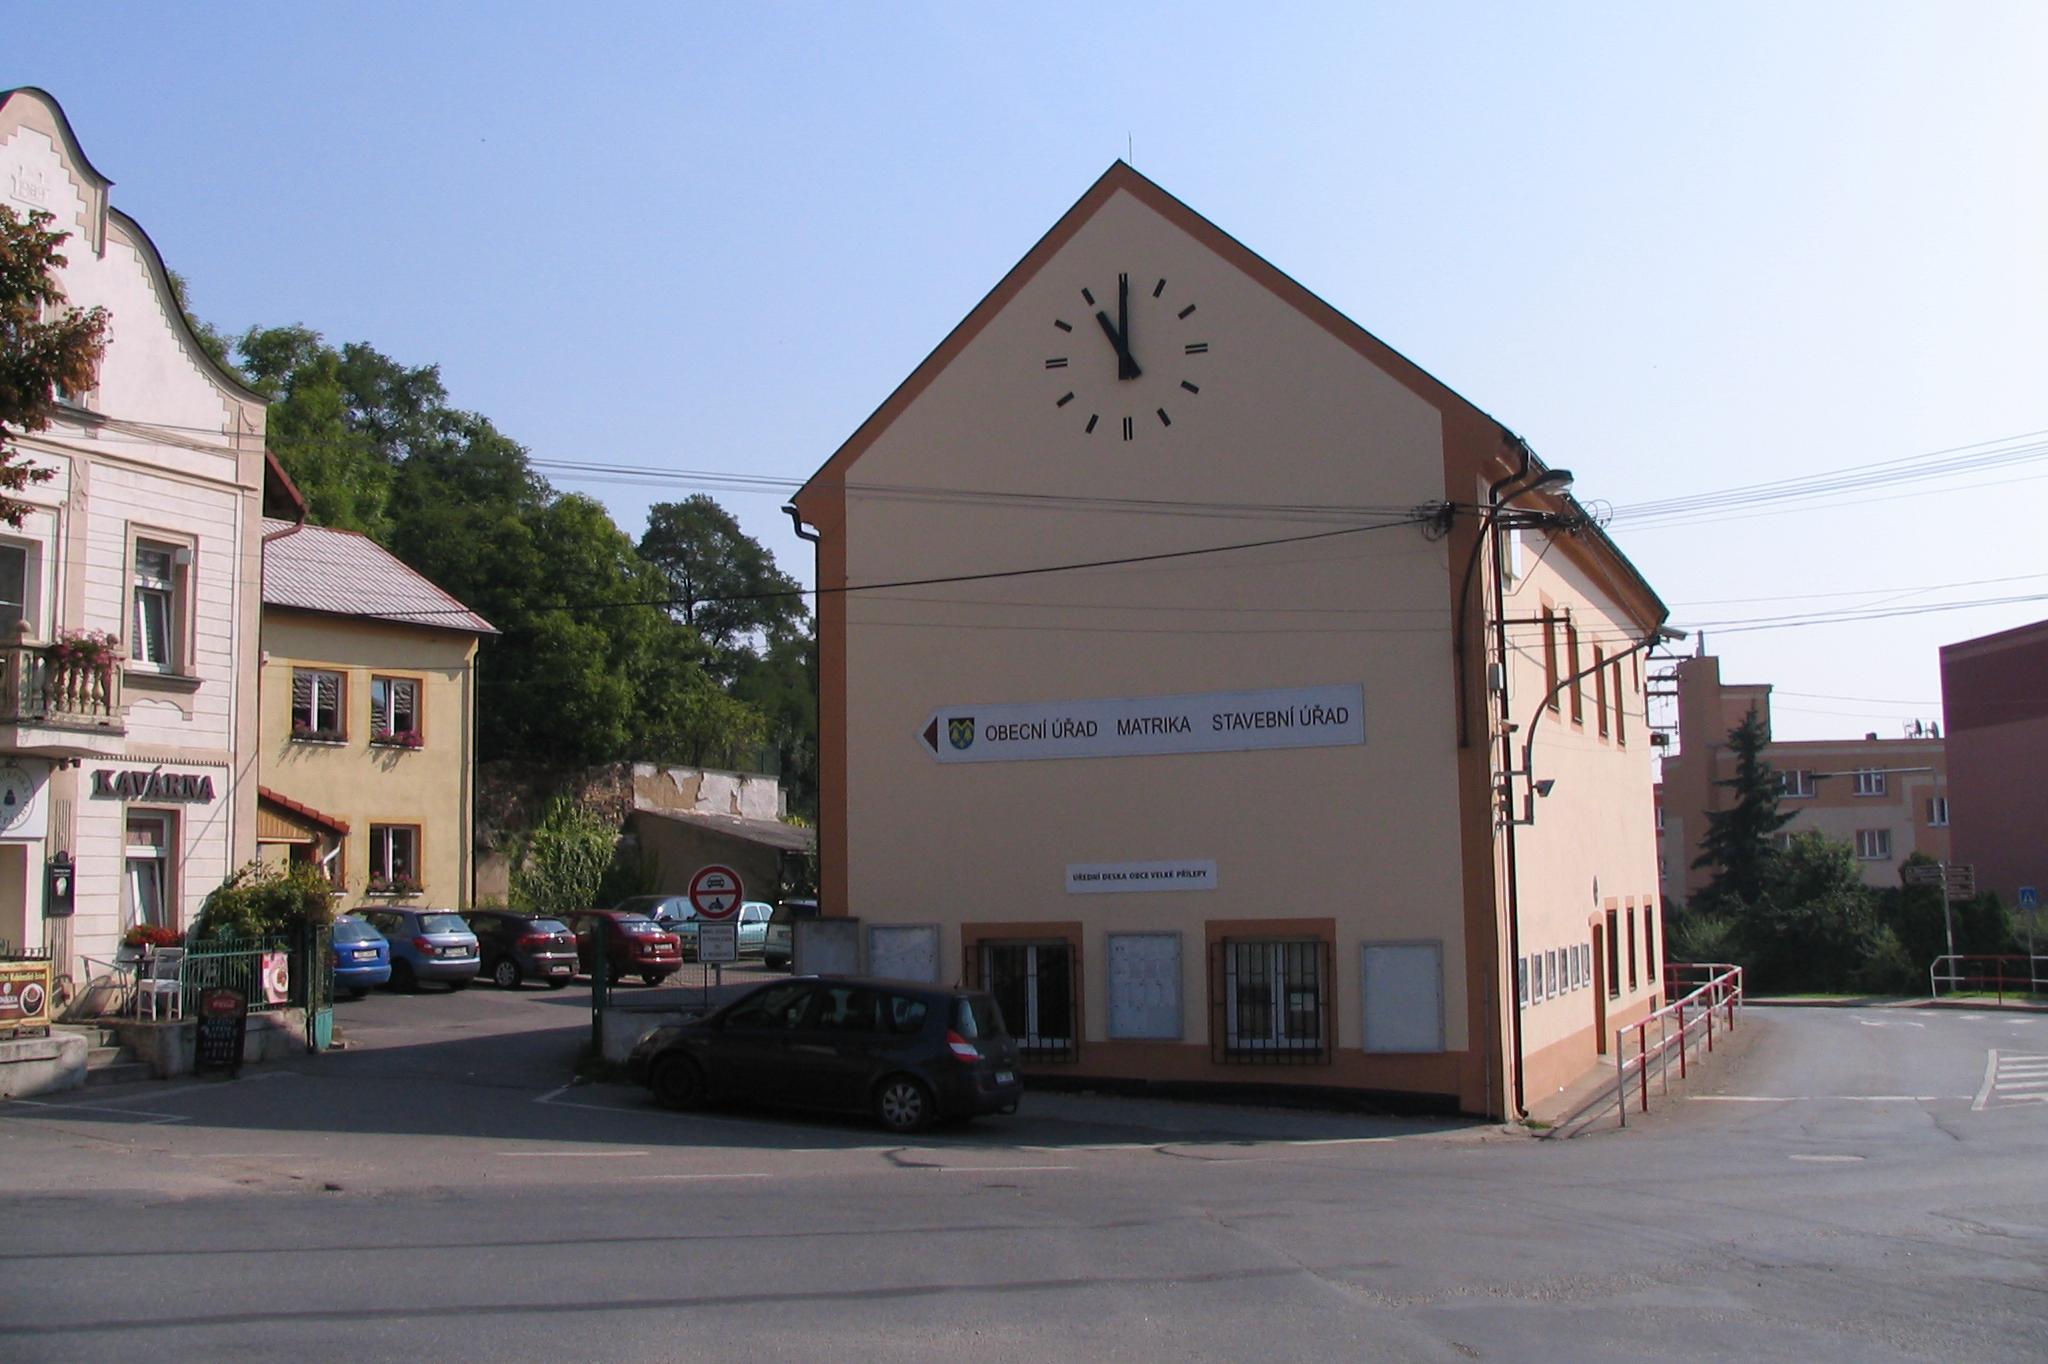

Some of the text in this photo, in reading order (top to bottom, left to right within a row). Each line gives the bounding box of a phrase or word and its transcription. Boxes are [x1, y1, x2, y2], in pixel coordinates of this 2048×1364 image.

[985, 717, 1098, 742] OBECNÍ ÚŘAD
[1117, 716, 1192, 736] MATRIKA
[1212, 704, 1349, 731] STAVEBNÍ ÚŘAD
[89, 764, 216, 804] KAVÁRNA
[1101, 872, 1127, 881] DESKA
[1129, 871, 1149, 880] OBCE
